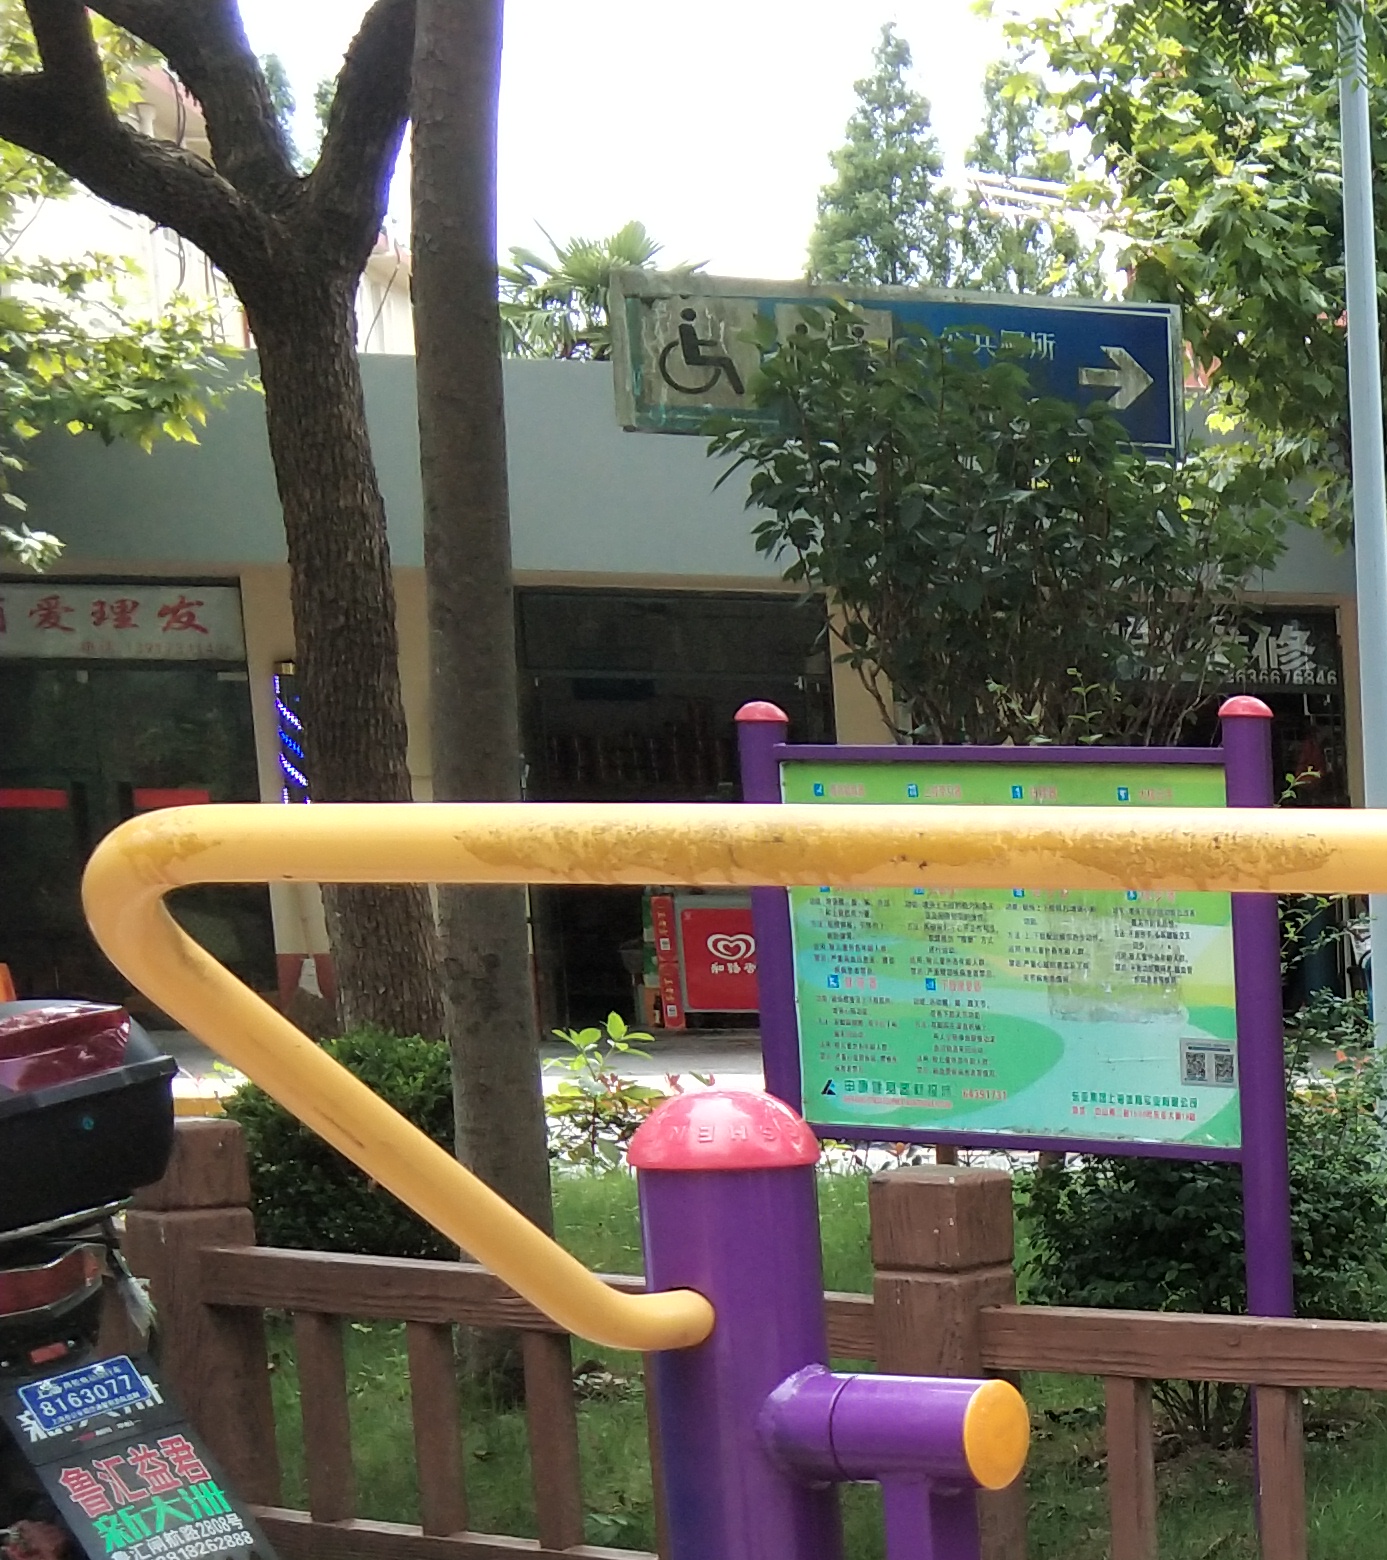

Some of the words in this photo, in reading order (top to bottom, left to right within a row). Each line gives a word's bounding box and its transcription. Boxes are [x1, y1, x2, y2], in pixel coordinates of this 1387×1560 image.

[38, 1373, 134, 1418] 8163077
[58, 1433, 213, 1518] 鲁汇益君
[92, 1480, 233, 1554] 新大洲
